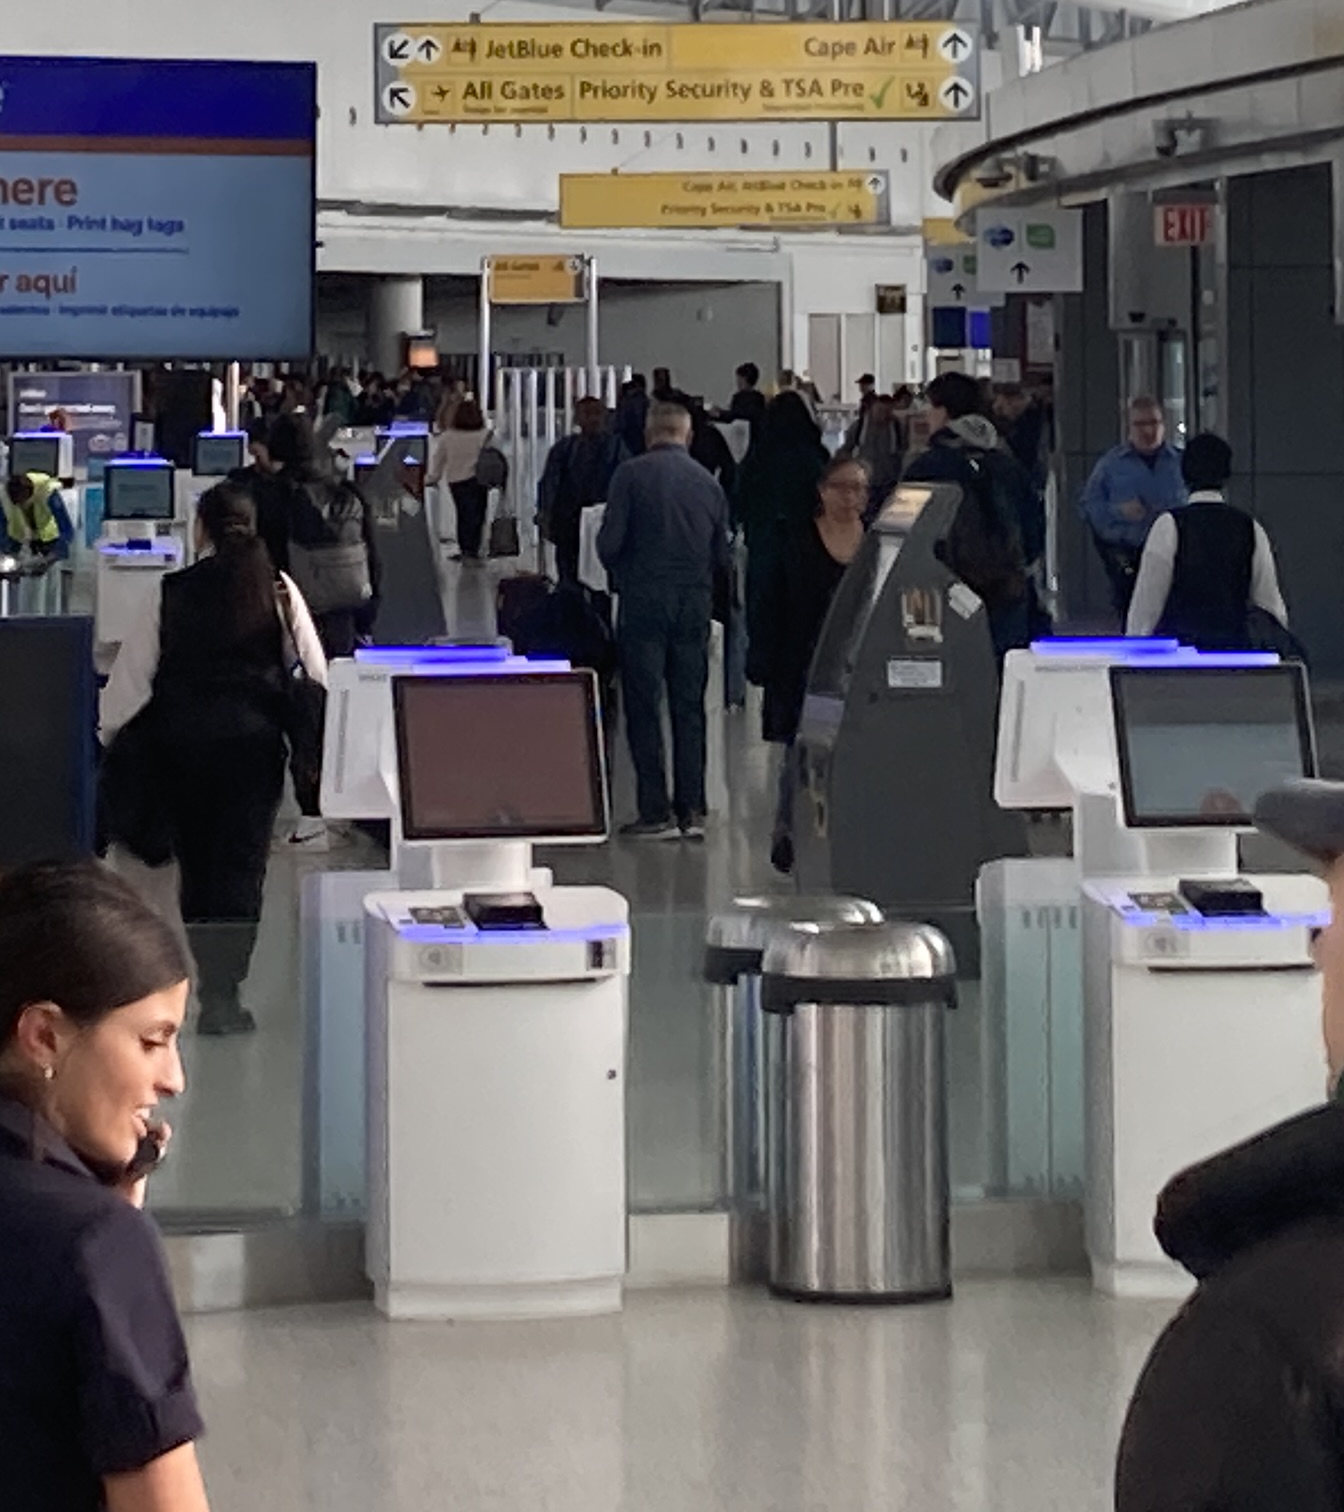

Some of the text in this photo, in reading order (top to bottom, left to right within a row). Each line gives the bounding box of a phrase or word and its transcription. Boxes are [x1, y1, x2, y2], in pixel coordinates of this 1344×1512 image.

[485, 36, 662, 60] JetBlue Check-in
[804, 36, 896, 60] Cape Air
[462, 79, 565, 101] All Gates
[579, 78, 864, 104] Priority Security & TSA Pre
[9, 215, 55, 231] seats
[67, 215, 106, 230] Print
[111, 215, 143, 237] bag
[147, 215, 185, 237] tags
[1163, 207, 1207, 242] EXIT
[15, 265, 78, 300] aquí
